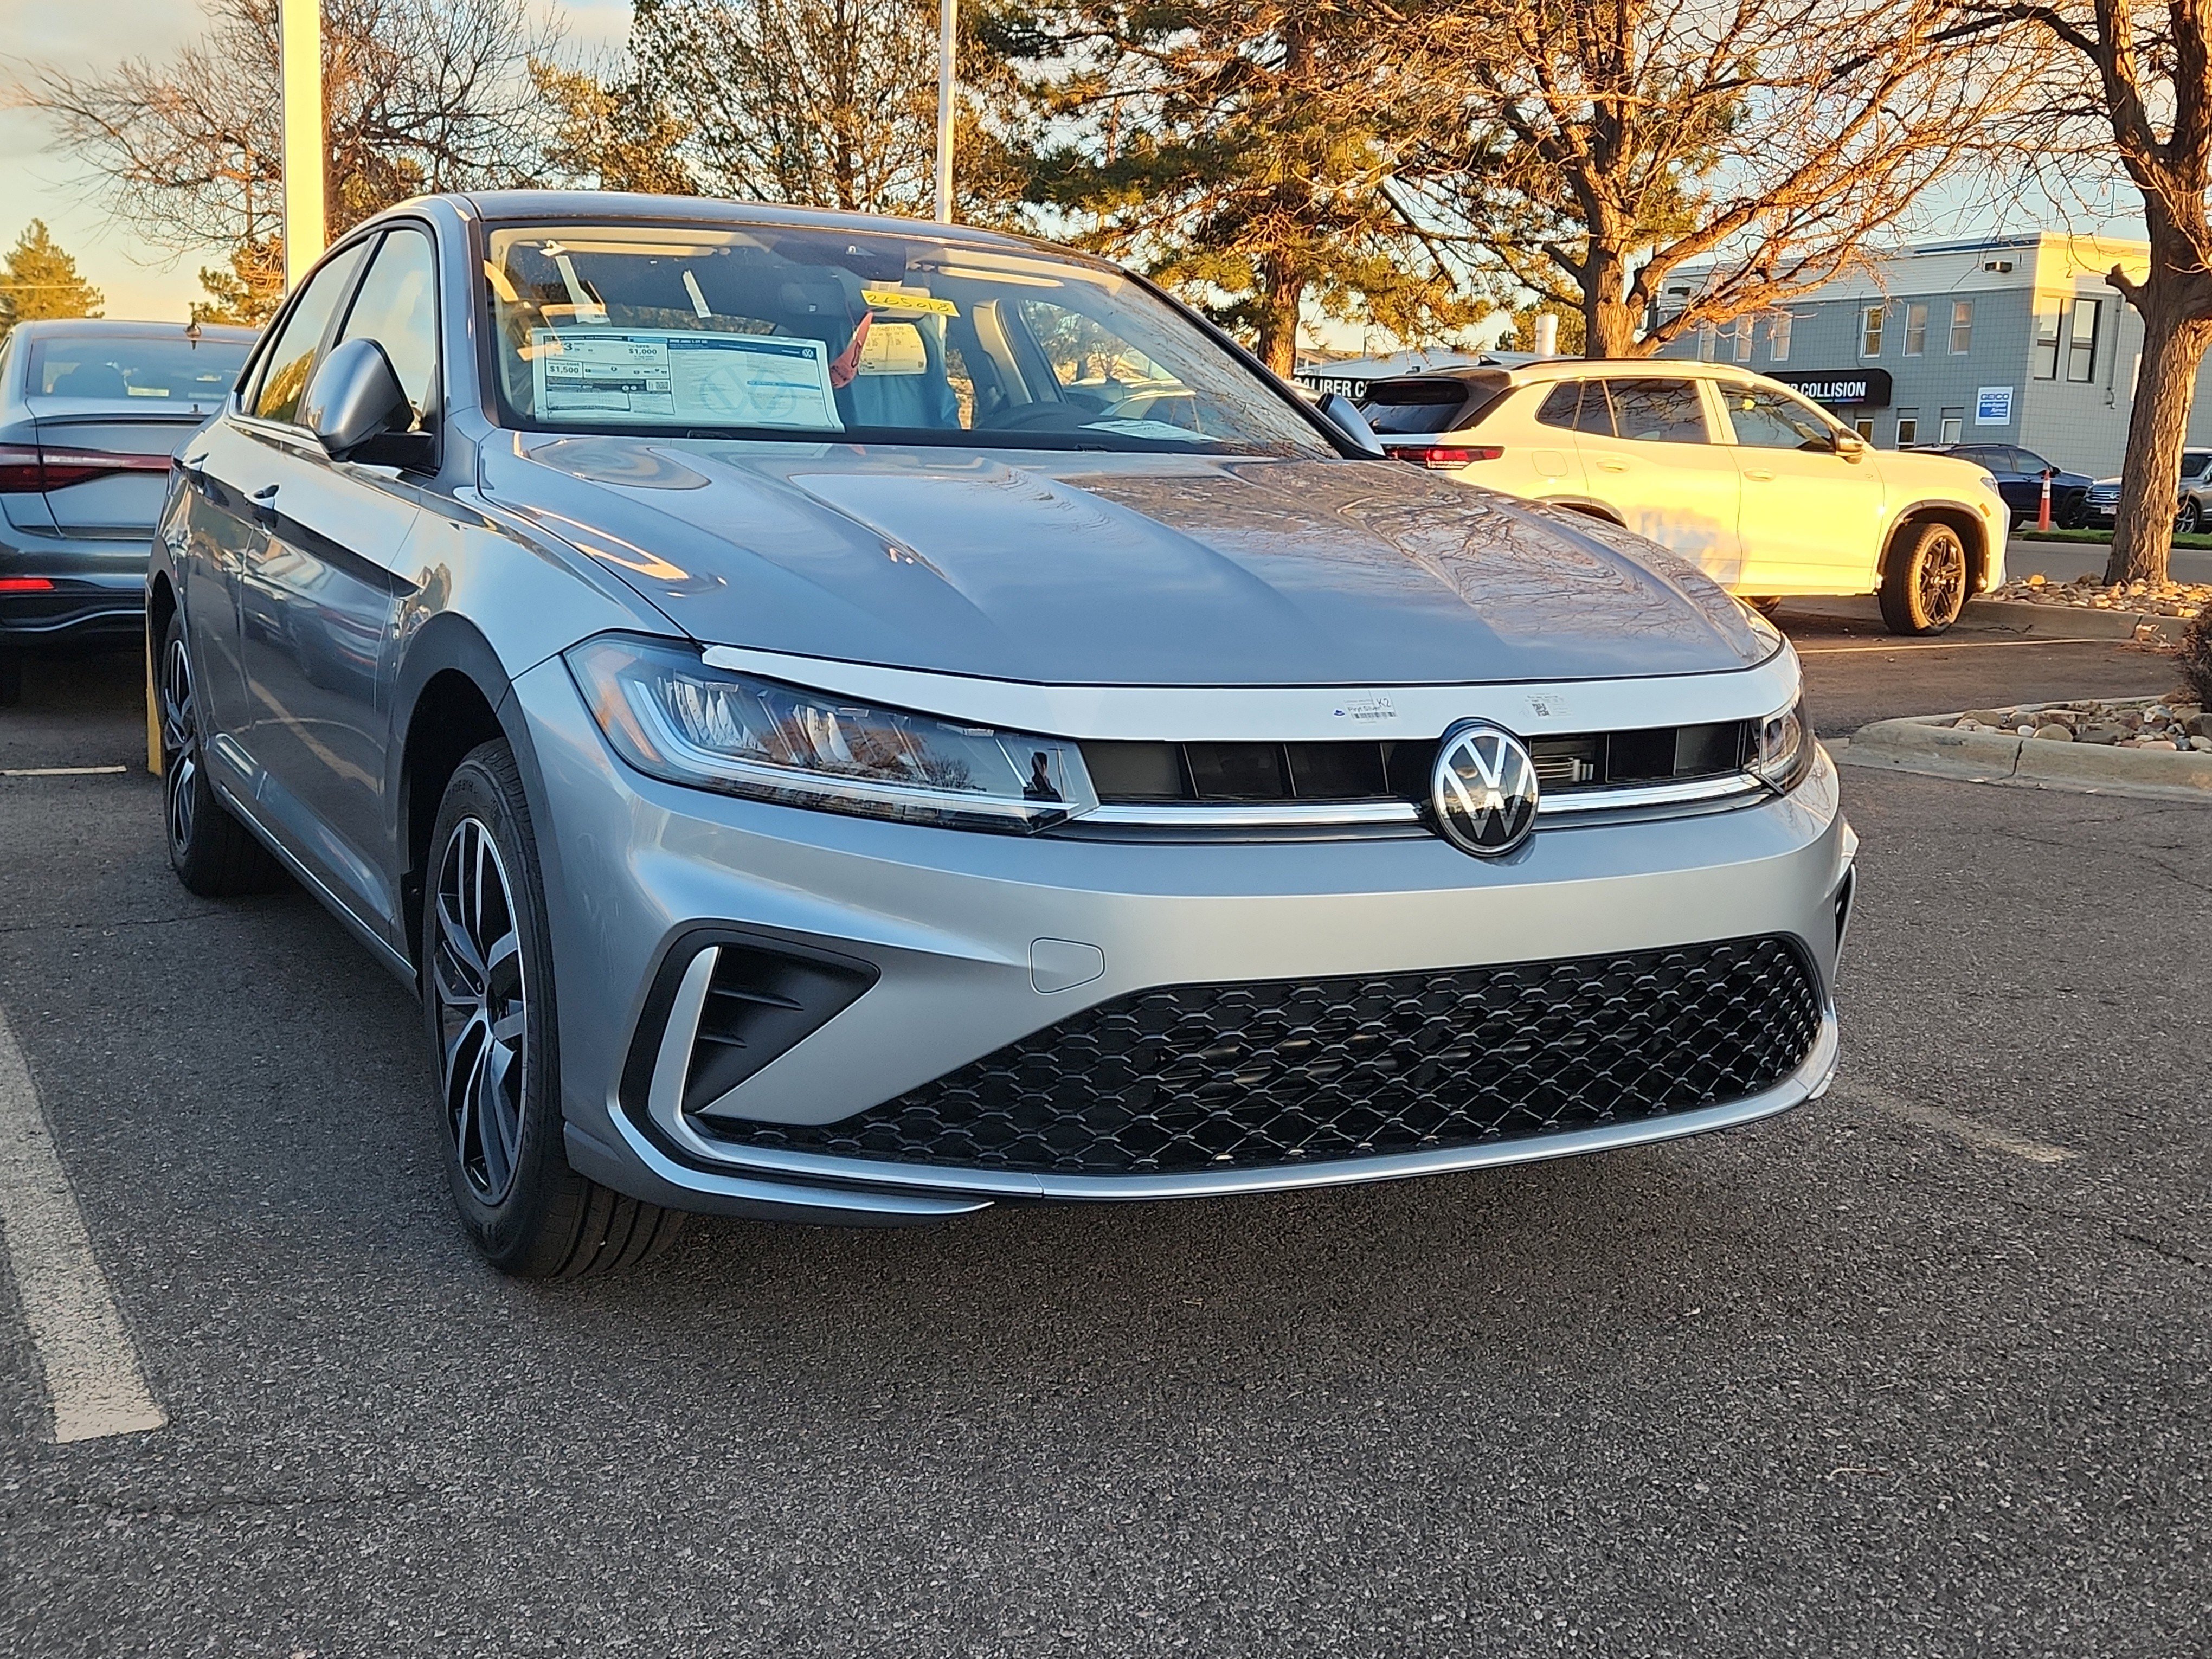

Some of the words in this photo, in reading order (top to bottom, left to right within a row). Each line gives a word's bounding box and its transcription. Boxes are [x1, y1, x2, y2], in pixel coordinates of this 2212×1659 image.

[550, 365, 579, 374] $1,500
[1801, 382, 1866, 397] COLLISION
[1377, 698, 1392, 708] K2
